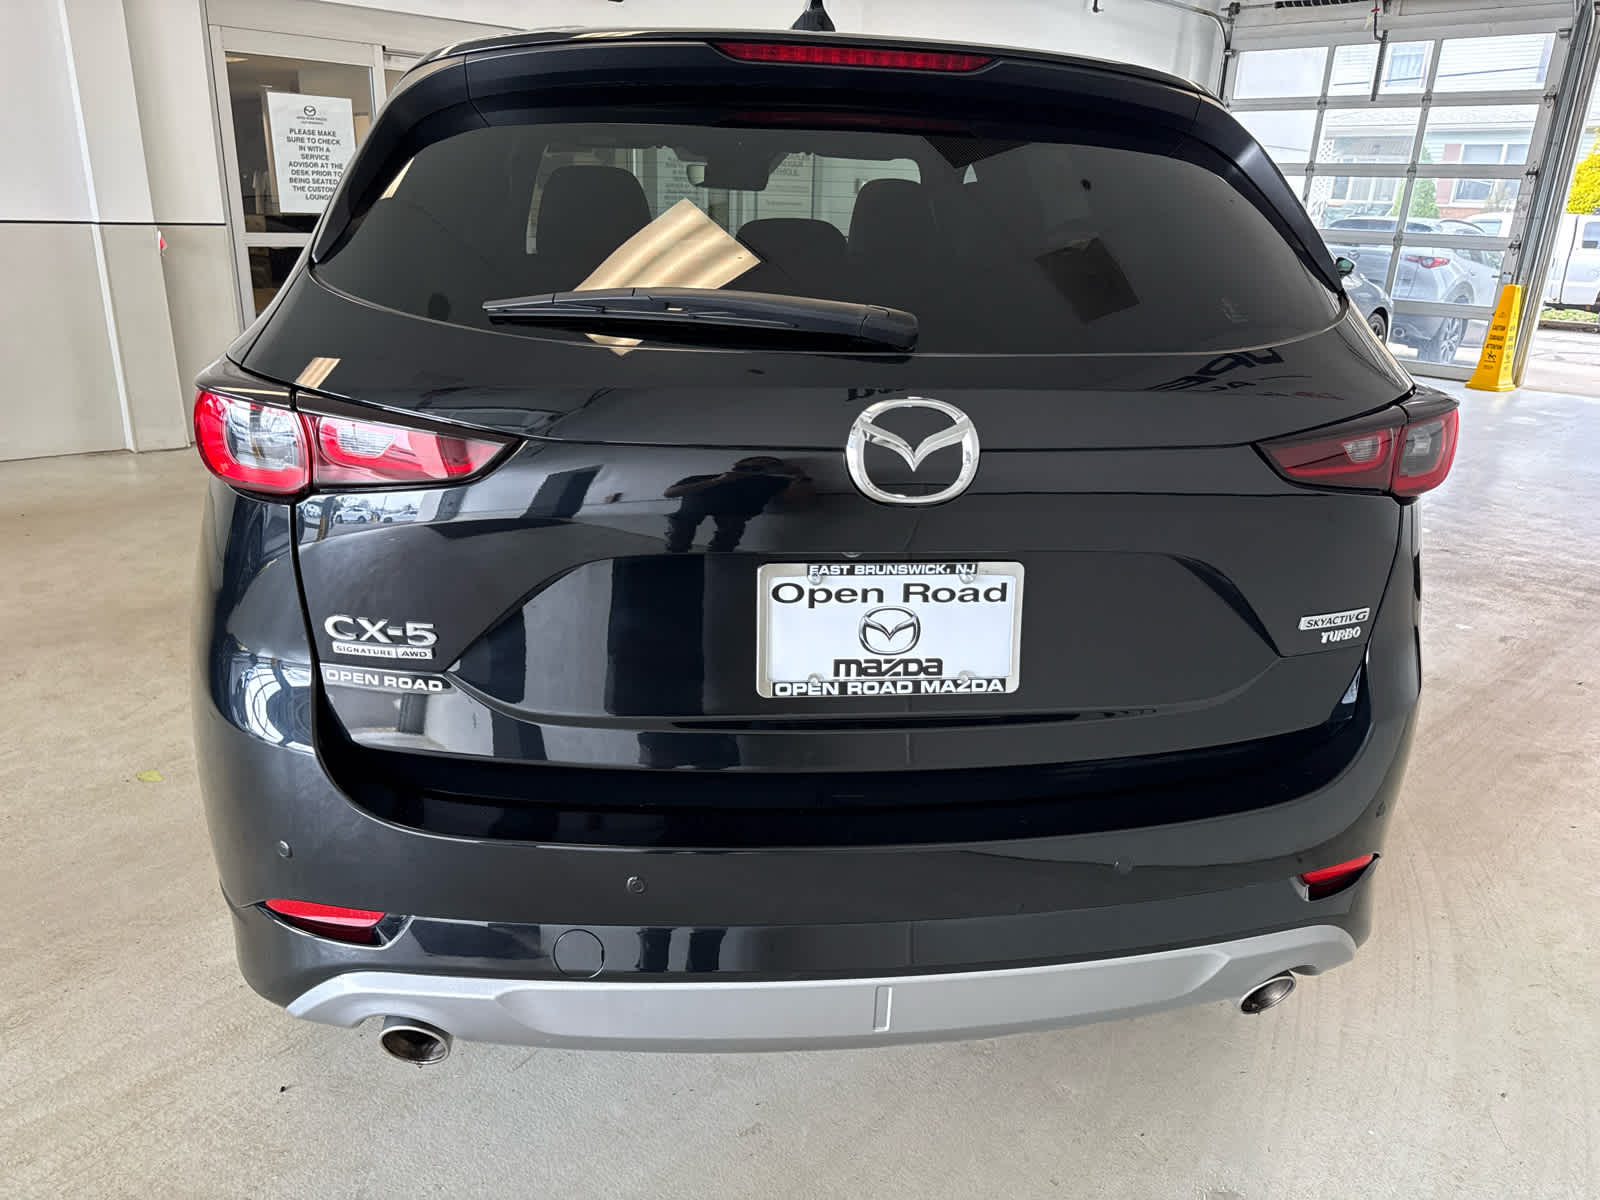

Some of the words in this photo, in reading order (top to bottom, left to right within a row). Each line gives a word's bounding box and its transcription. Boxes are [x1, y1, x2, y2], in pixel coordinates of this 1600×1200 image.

[289, 128, 317, 136] PLEASE
[312, 177, 338, 185] SEATED
[809, 565, 850, 575] EAST
[955, 564, 976, 574] NJ
[771, 582, 884, 608] Open
[902, 582, 1008, 603] Road
[324, 614, 438, 647] CX-5
[1321, 626, 1361, 644] TURBO
[336, 645, 393, 656] SIGNATURE
[833, 658, 943, 677] mazda
[325, 669, 379, 685] OPEN
[383, 675, 443, 691] ROAD
[774, 681, 839, 695] OPEN
[847, 681, 913, 694] ROAD
[920, 679, 1005, 693] MAZDA
